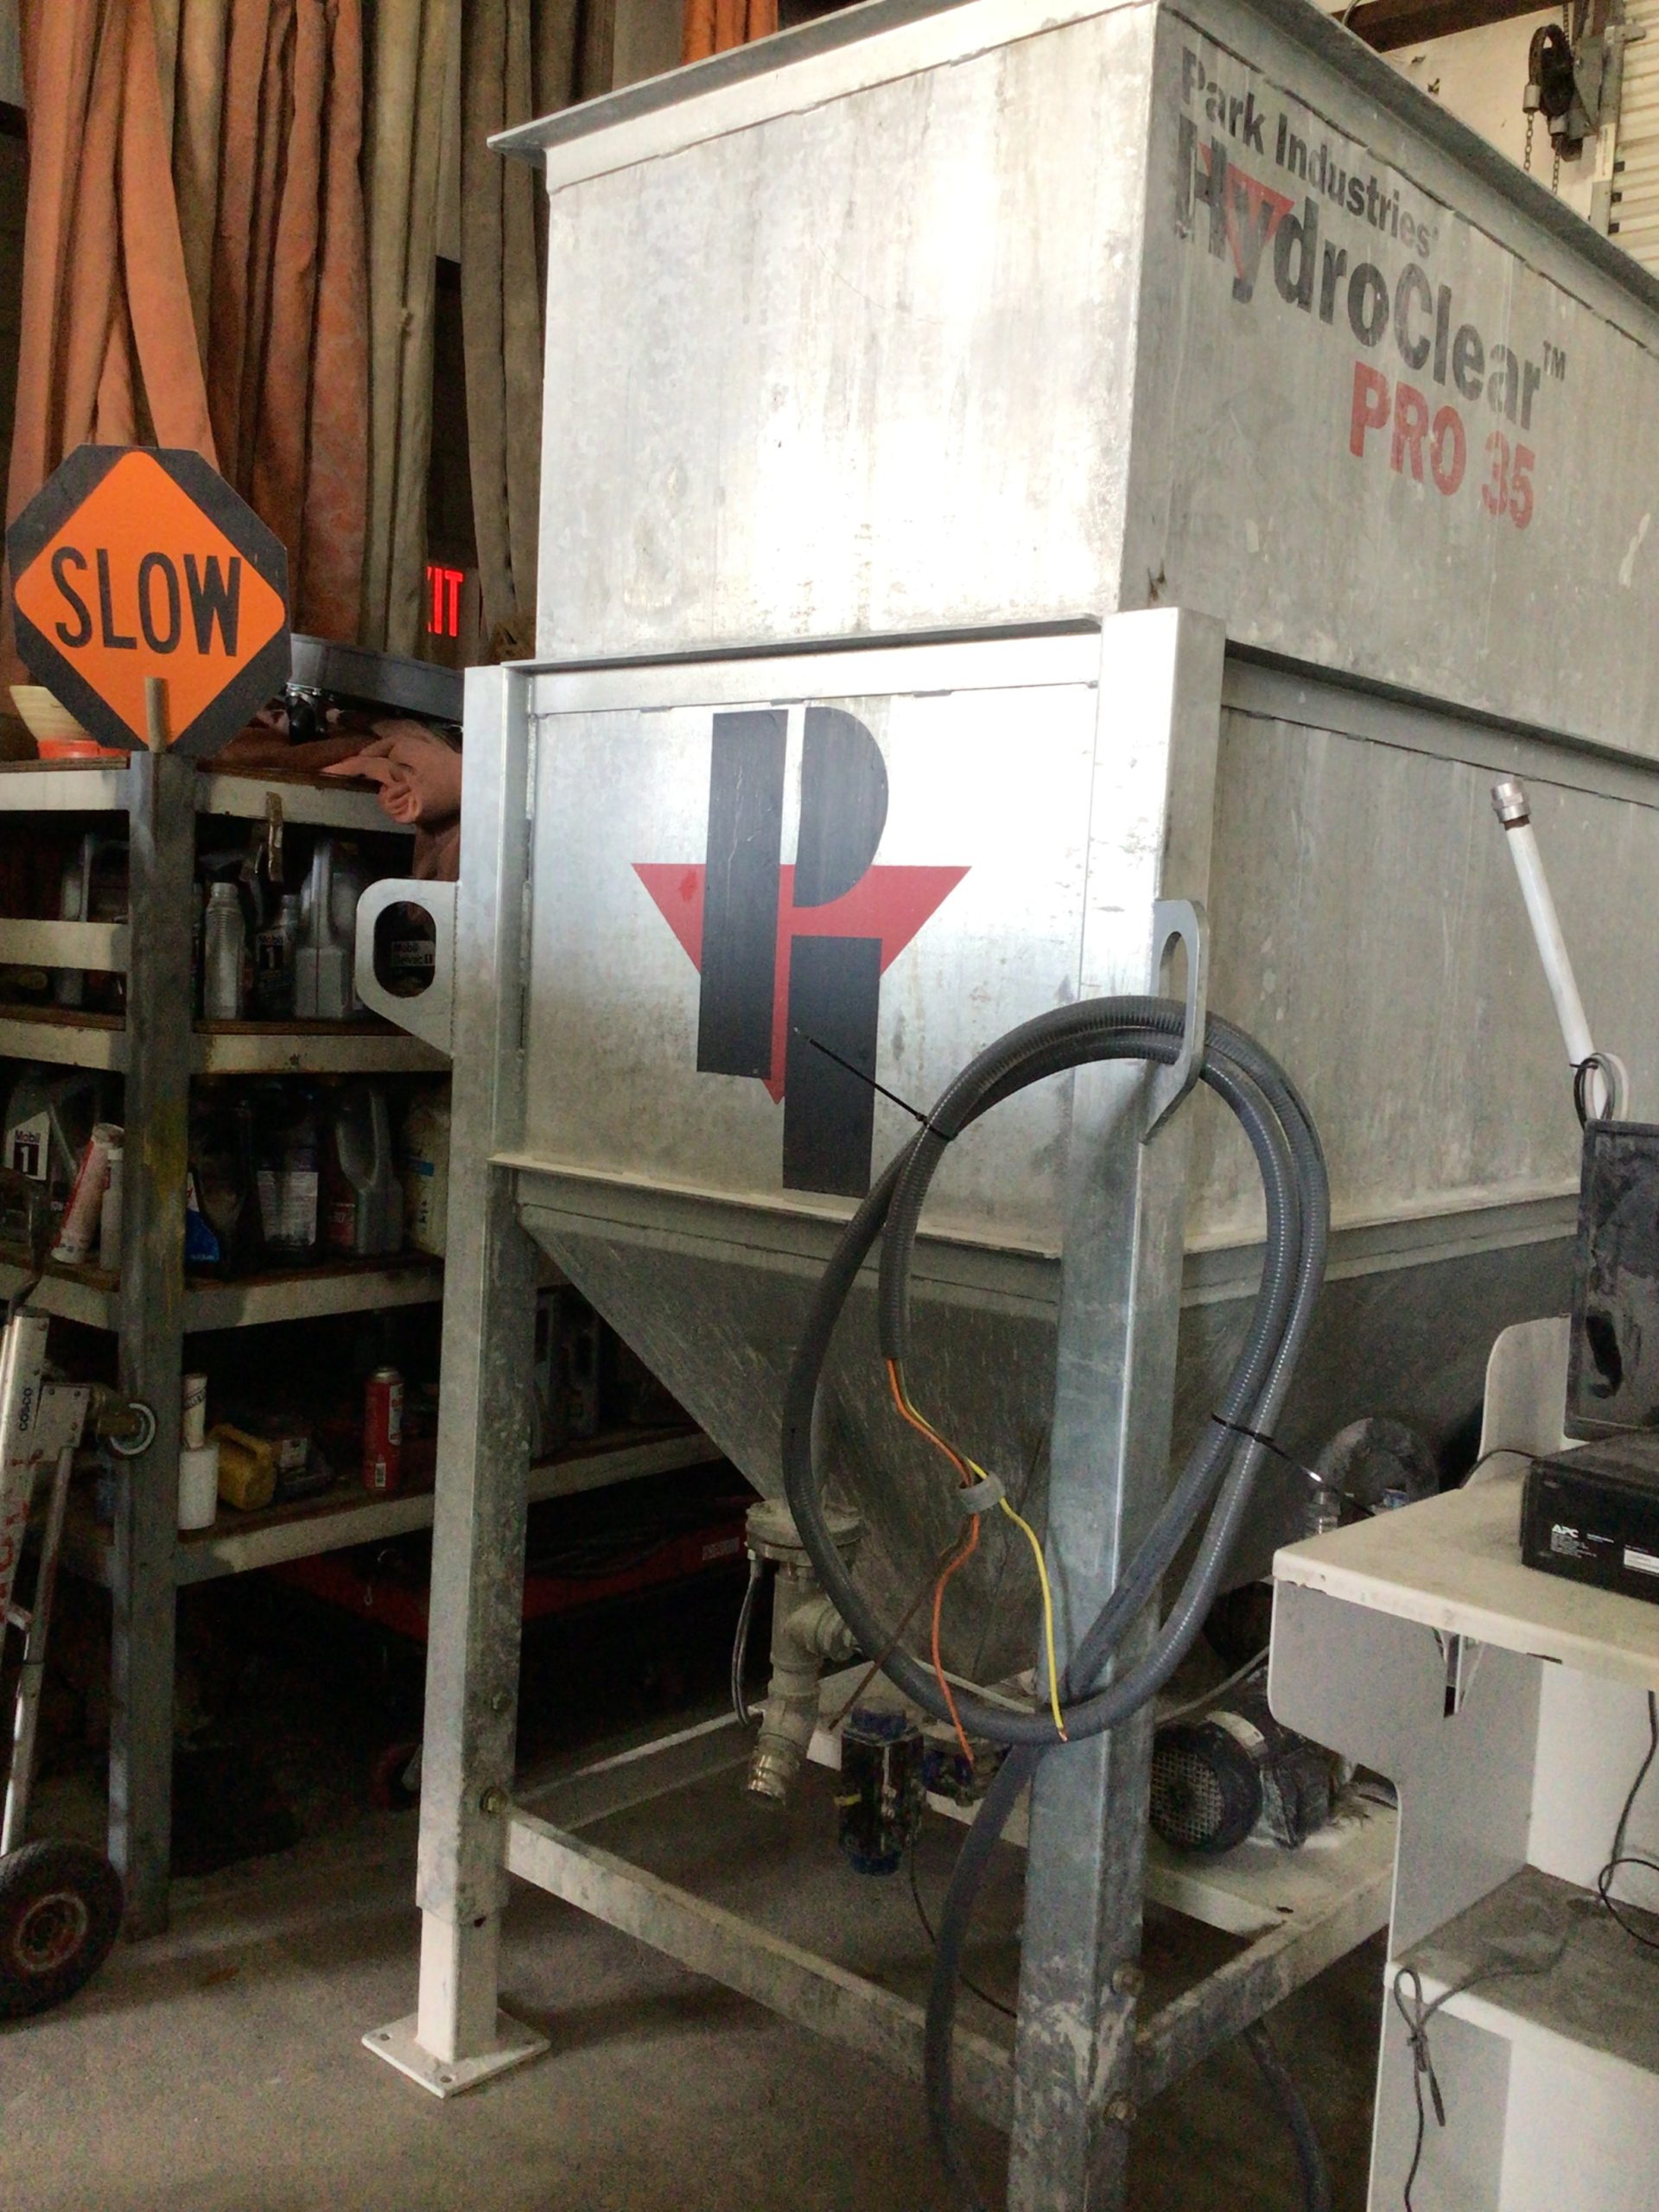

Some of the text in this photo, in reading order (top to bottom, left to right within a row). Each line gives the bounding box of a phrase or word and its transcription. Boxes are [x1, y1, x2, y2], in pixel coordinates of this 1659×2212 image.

[1181, 47, 1433, 258] Park Industries
[1349, 359, 1535, 530] PRO 35
[50, 546, 242, 658] SLOW
[15, 1128, 41, 1144] Mobil
[20, 1146, 30, 1173] 1
[18, 1387, 33, 1432] COSCO
[1551, 1523, 1580, 1539] APC
